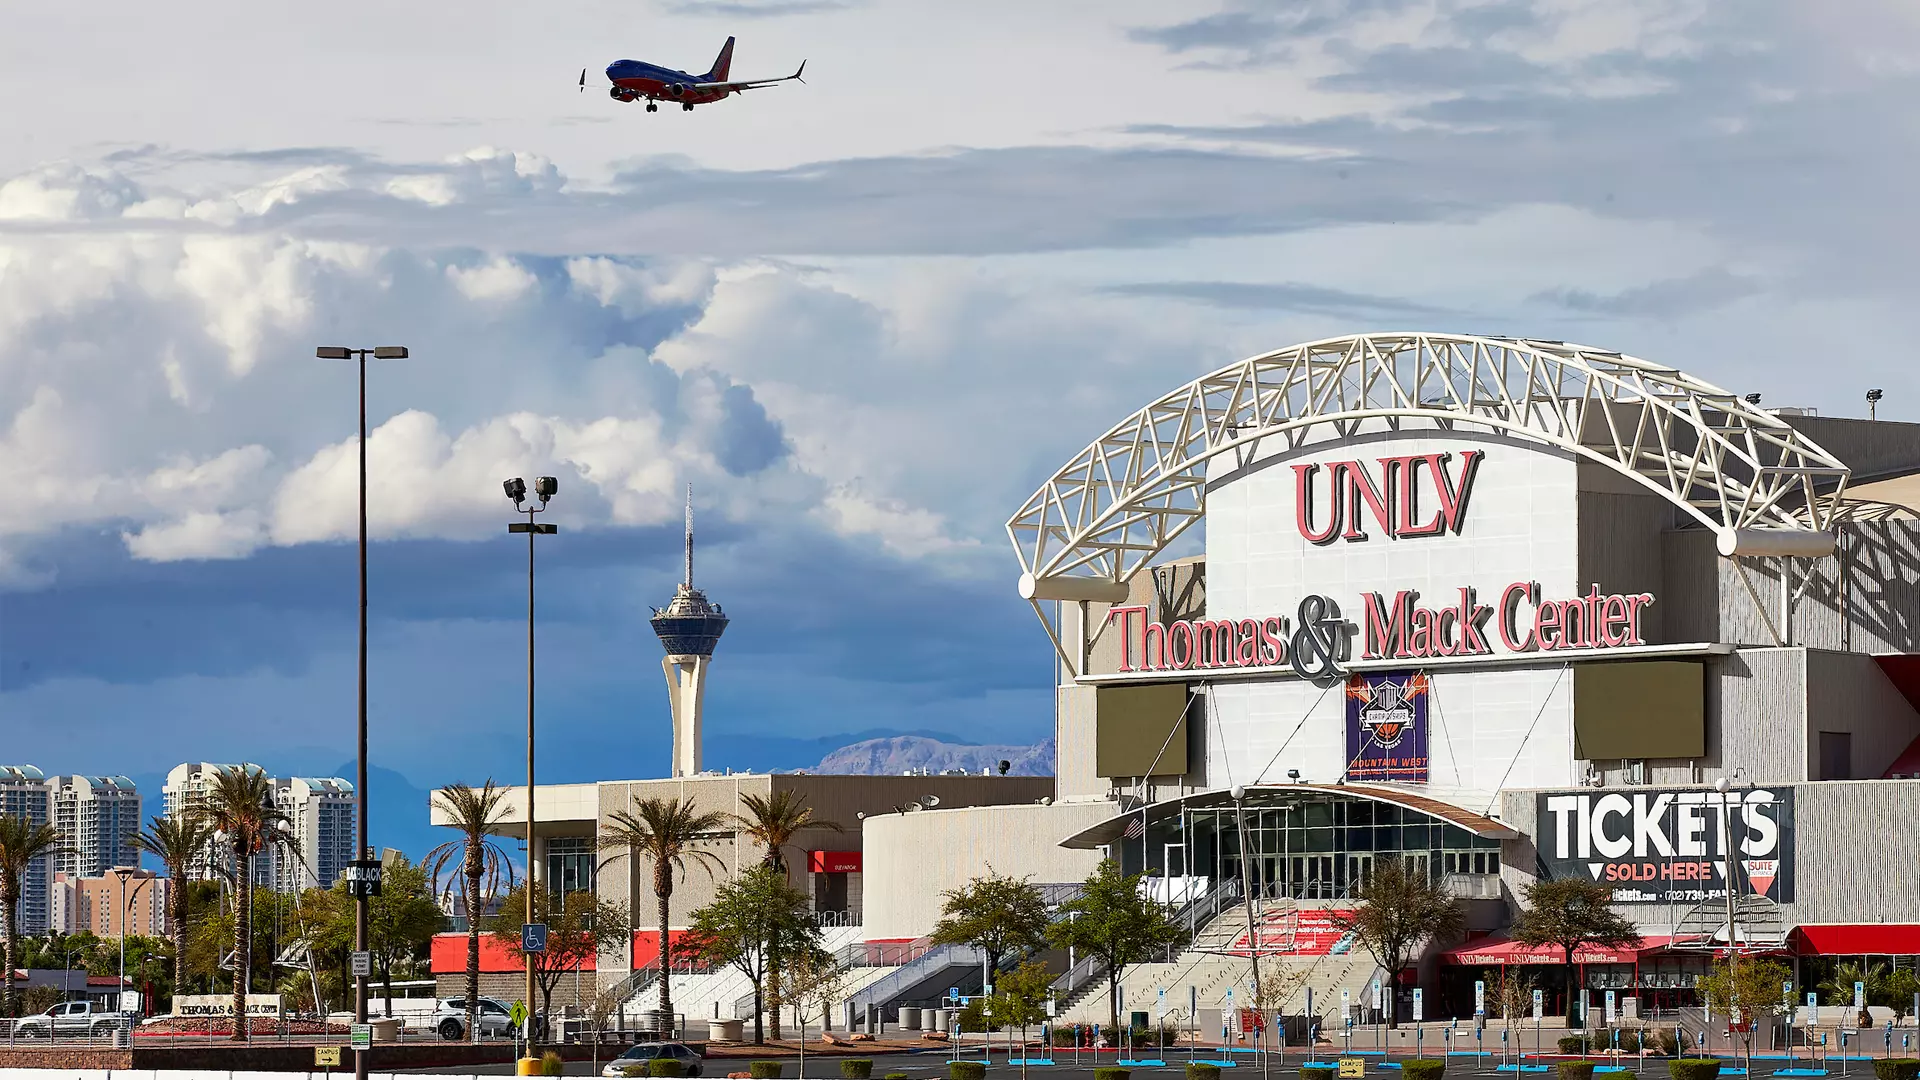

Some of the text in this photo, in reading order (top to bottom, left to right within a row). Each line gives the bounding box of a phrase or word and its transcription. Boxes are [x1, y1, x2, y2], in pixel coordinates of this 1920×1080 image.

[1290, 450, 1484, 545] UNLV
[1109, 582, 1653, 683] Thomas & Mack Center
[1350, 757, 1427, 768] MOUNTAIN WEST
[1548, 790, 1778, 859] TICKETS
[1606, 862, 1712, 881] SOLD HERE
[1749, 861, 1773, 871] SUITE
[357, 867, 382, 882] BLACK
[365, 882, 373, 895] 2
[1664, 890, 1685, 900] (702)
[180, 1005, 225, 1015] THOMAS
[227, 1005, 234, 1014] &
[245, 1005, 260, 1014] ACK
